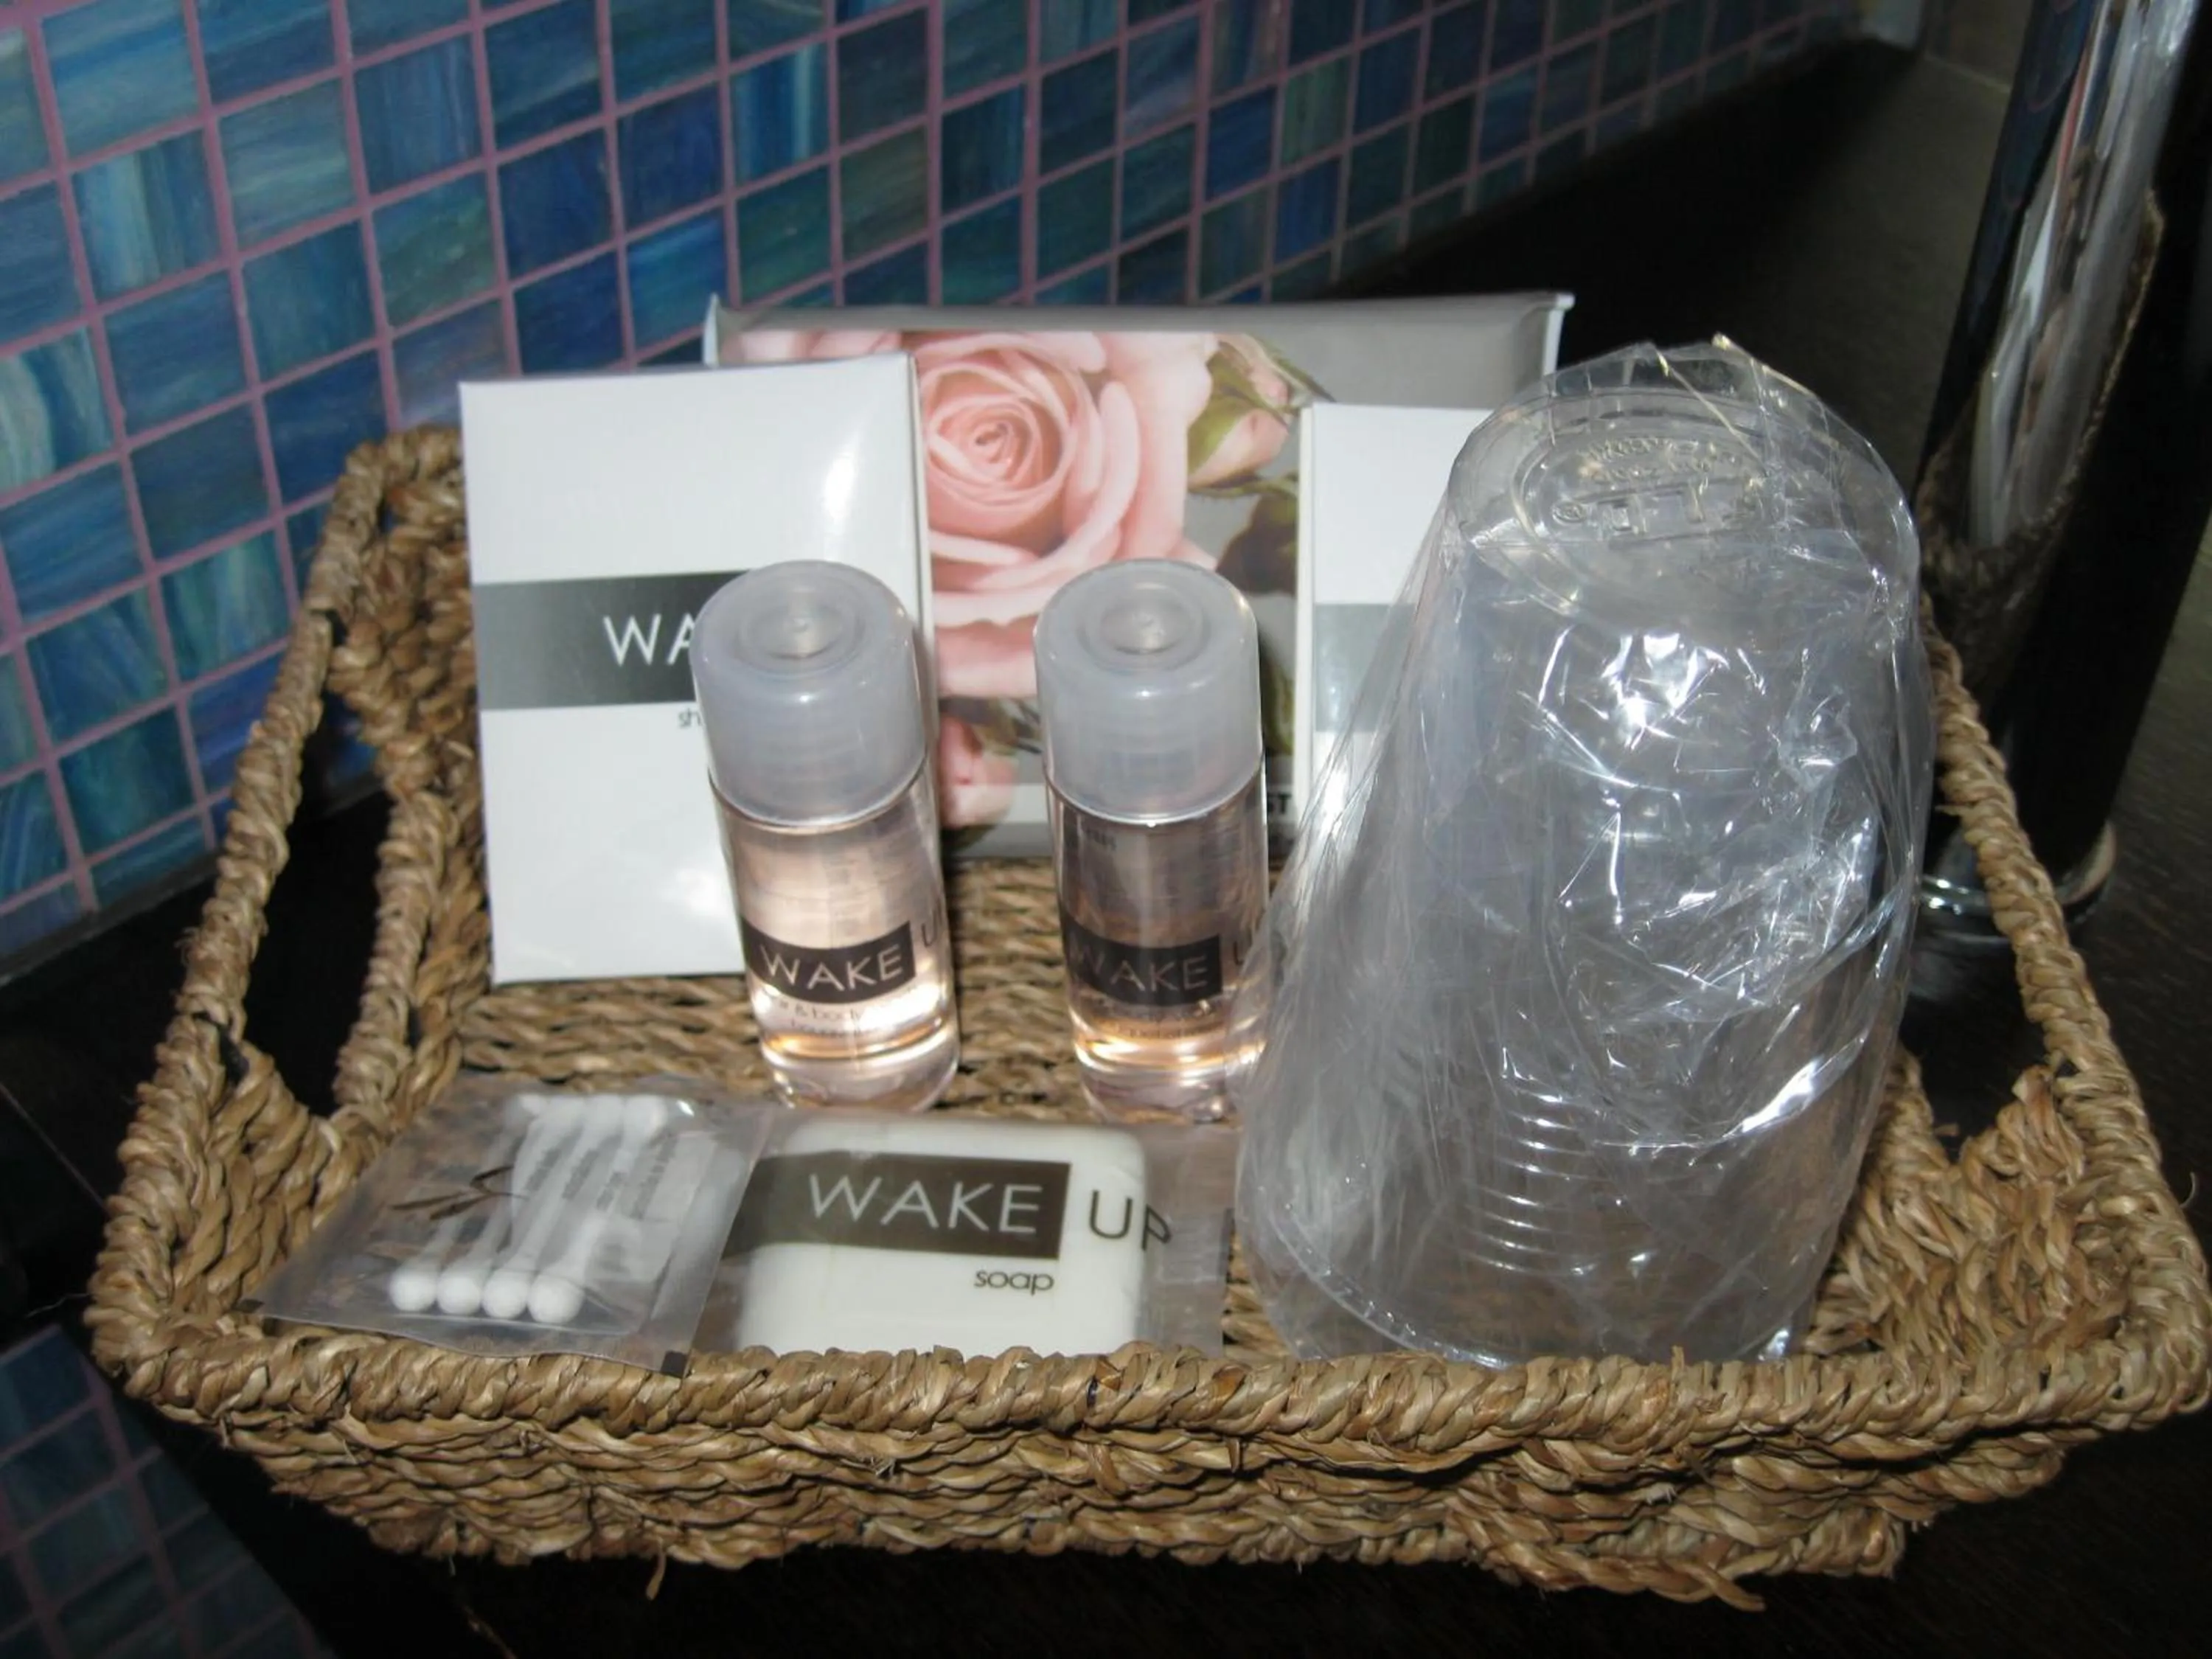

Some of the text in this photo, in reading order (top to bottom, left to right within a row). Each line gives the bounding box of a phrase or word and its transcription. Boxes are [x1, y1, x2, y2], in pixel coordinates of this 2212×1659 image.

[759, 943, 904, 992] WAKE
[1069, 931, 1208, 992] WAKE
[809, 1173, 1173, 1252] WAKE UP
[973, 1268, 1054, 1295] soap
